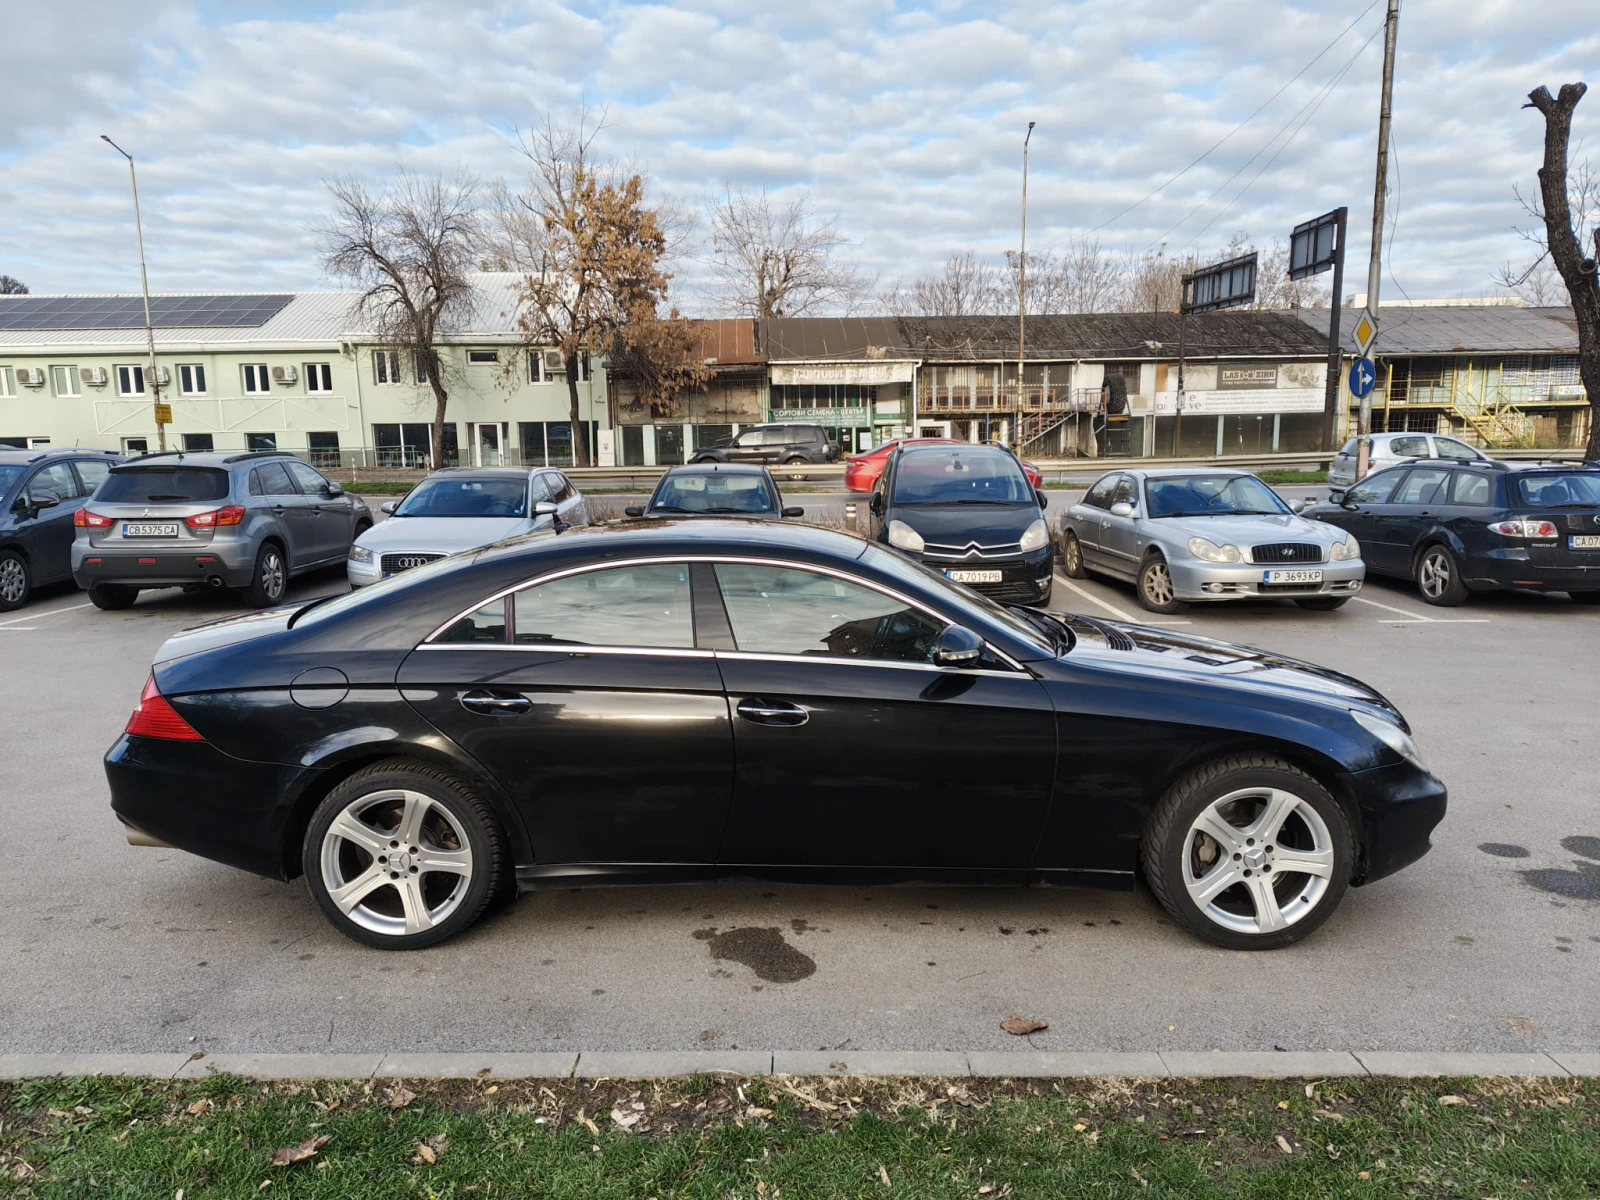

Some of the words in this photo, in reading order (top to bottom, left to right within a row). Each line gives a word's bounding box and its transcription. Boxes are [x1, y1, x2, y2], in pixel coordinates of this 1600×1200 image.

[773, 409, 806, 417] СОРТОВИ
[141, 525, 162, 534] 5375
[164, 525, 175, 534] CA
